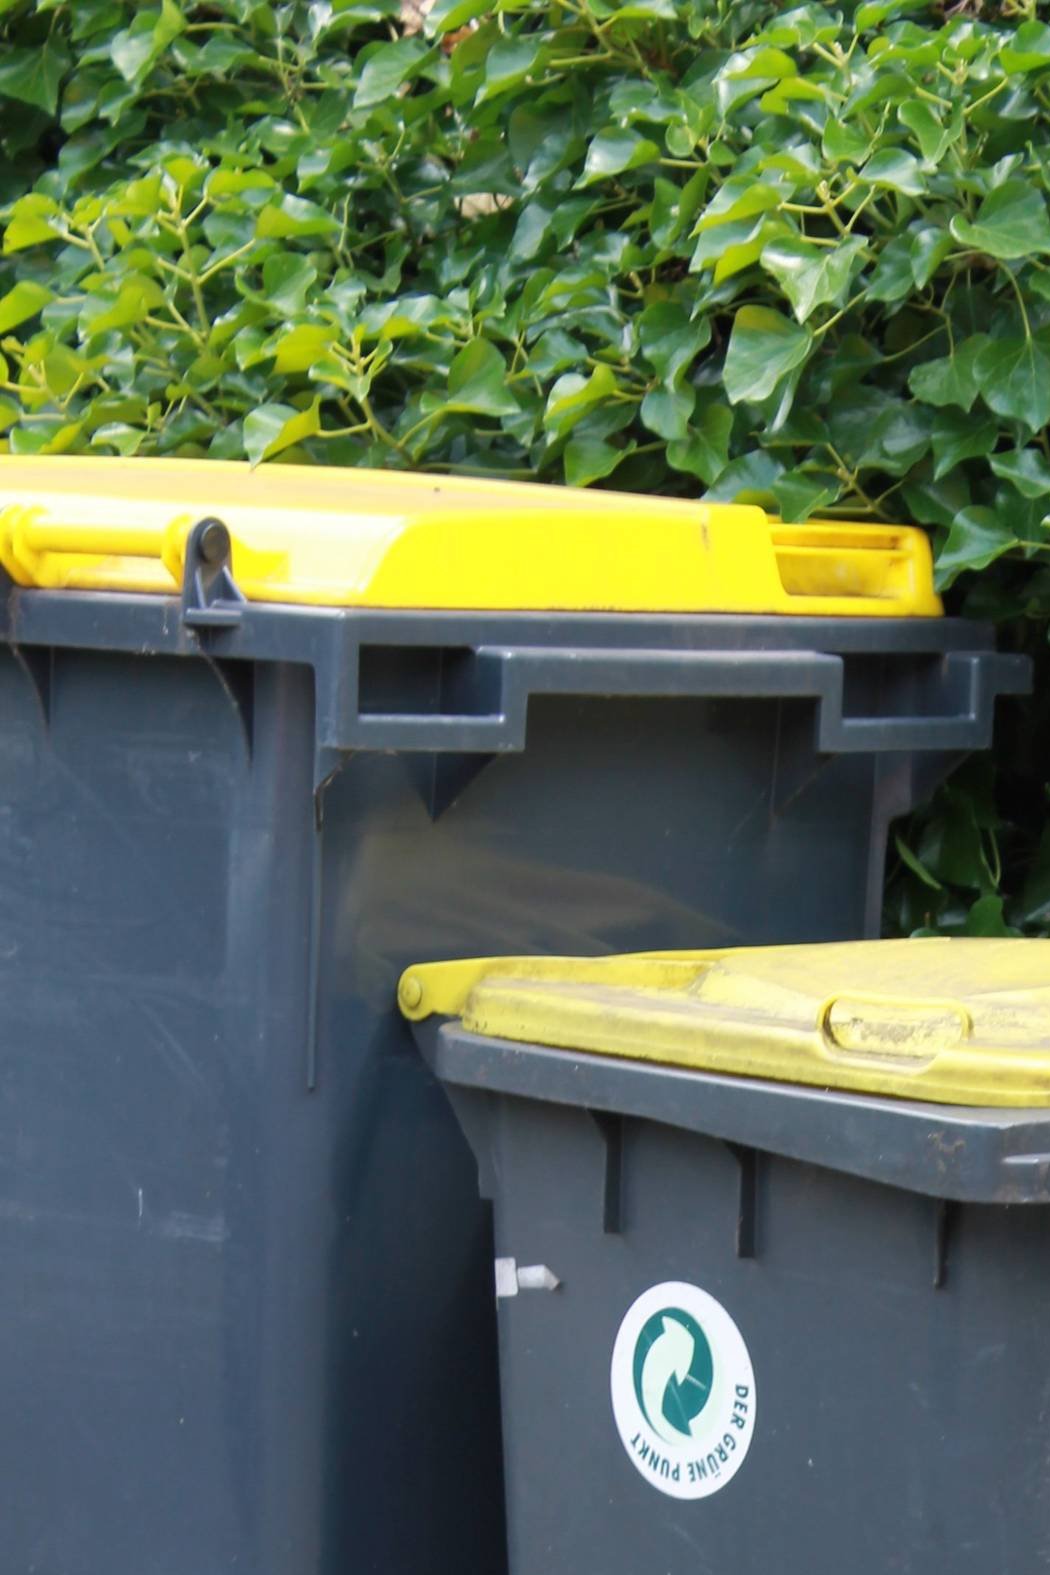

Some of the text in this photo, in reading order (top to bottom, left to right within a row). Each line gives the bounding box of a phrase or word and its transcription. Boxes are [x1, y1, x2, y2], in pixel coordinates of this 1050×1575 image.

[630, 1384, 749, 1482] DER GRÜNE PUNKT
